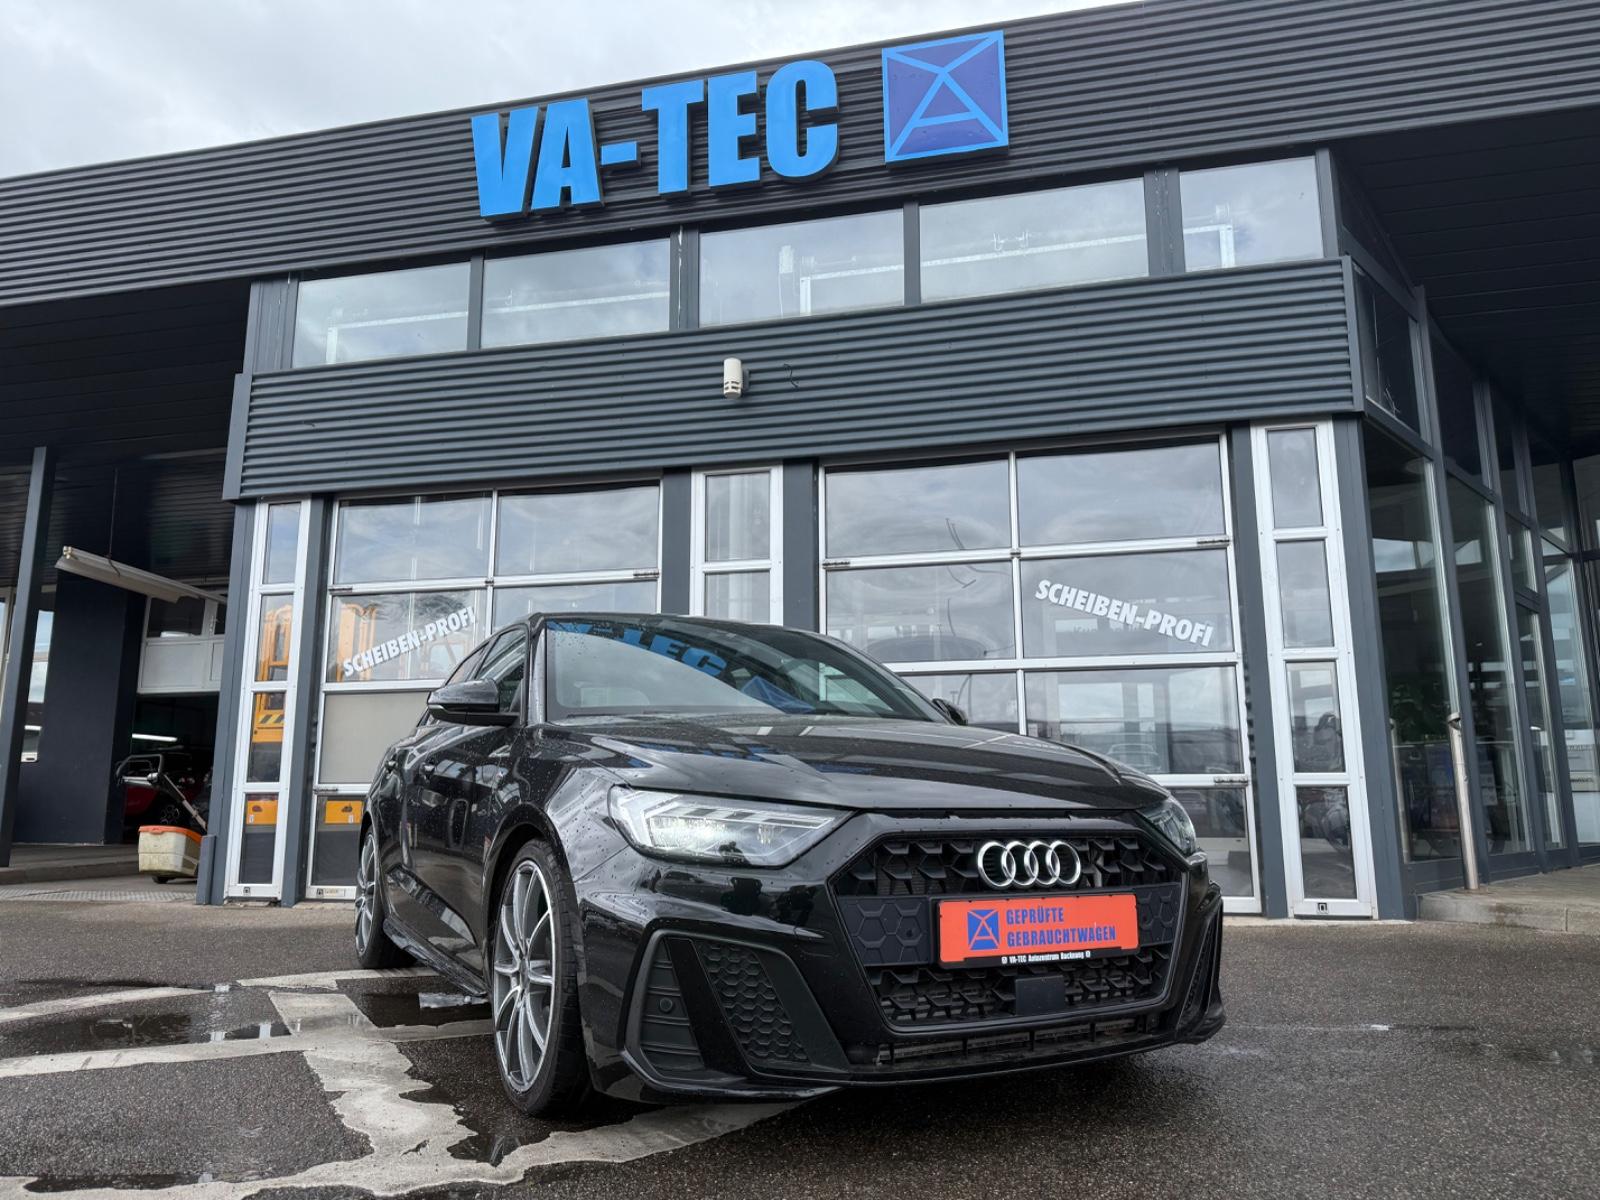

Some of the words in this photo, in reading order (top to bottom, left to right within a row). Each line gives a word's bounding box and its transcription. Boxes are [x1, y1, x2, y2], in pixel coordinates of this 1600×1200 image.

[471, 60, 838, 217] VA-TEC
[343, 606, 475, 677] SCHEIBEN-PROFI
[1035, 579, 1213, 647] SCHEIBEN-PROFI
[1006, 906, 1064, 925] GEPRÜFTE
[1007, 926, 1116, 947] GEBRAUCHTWAGEN
